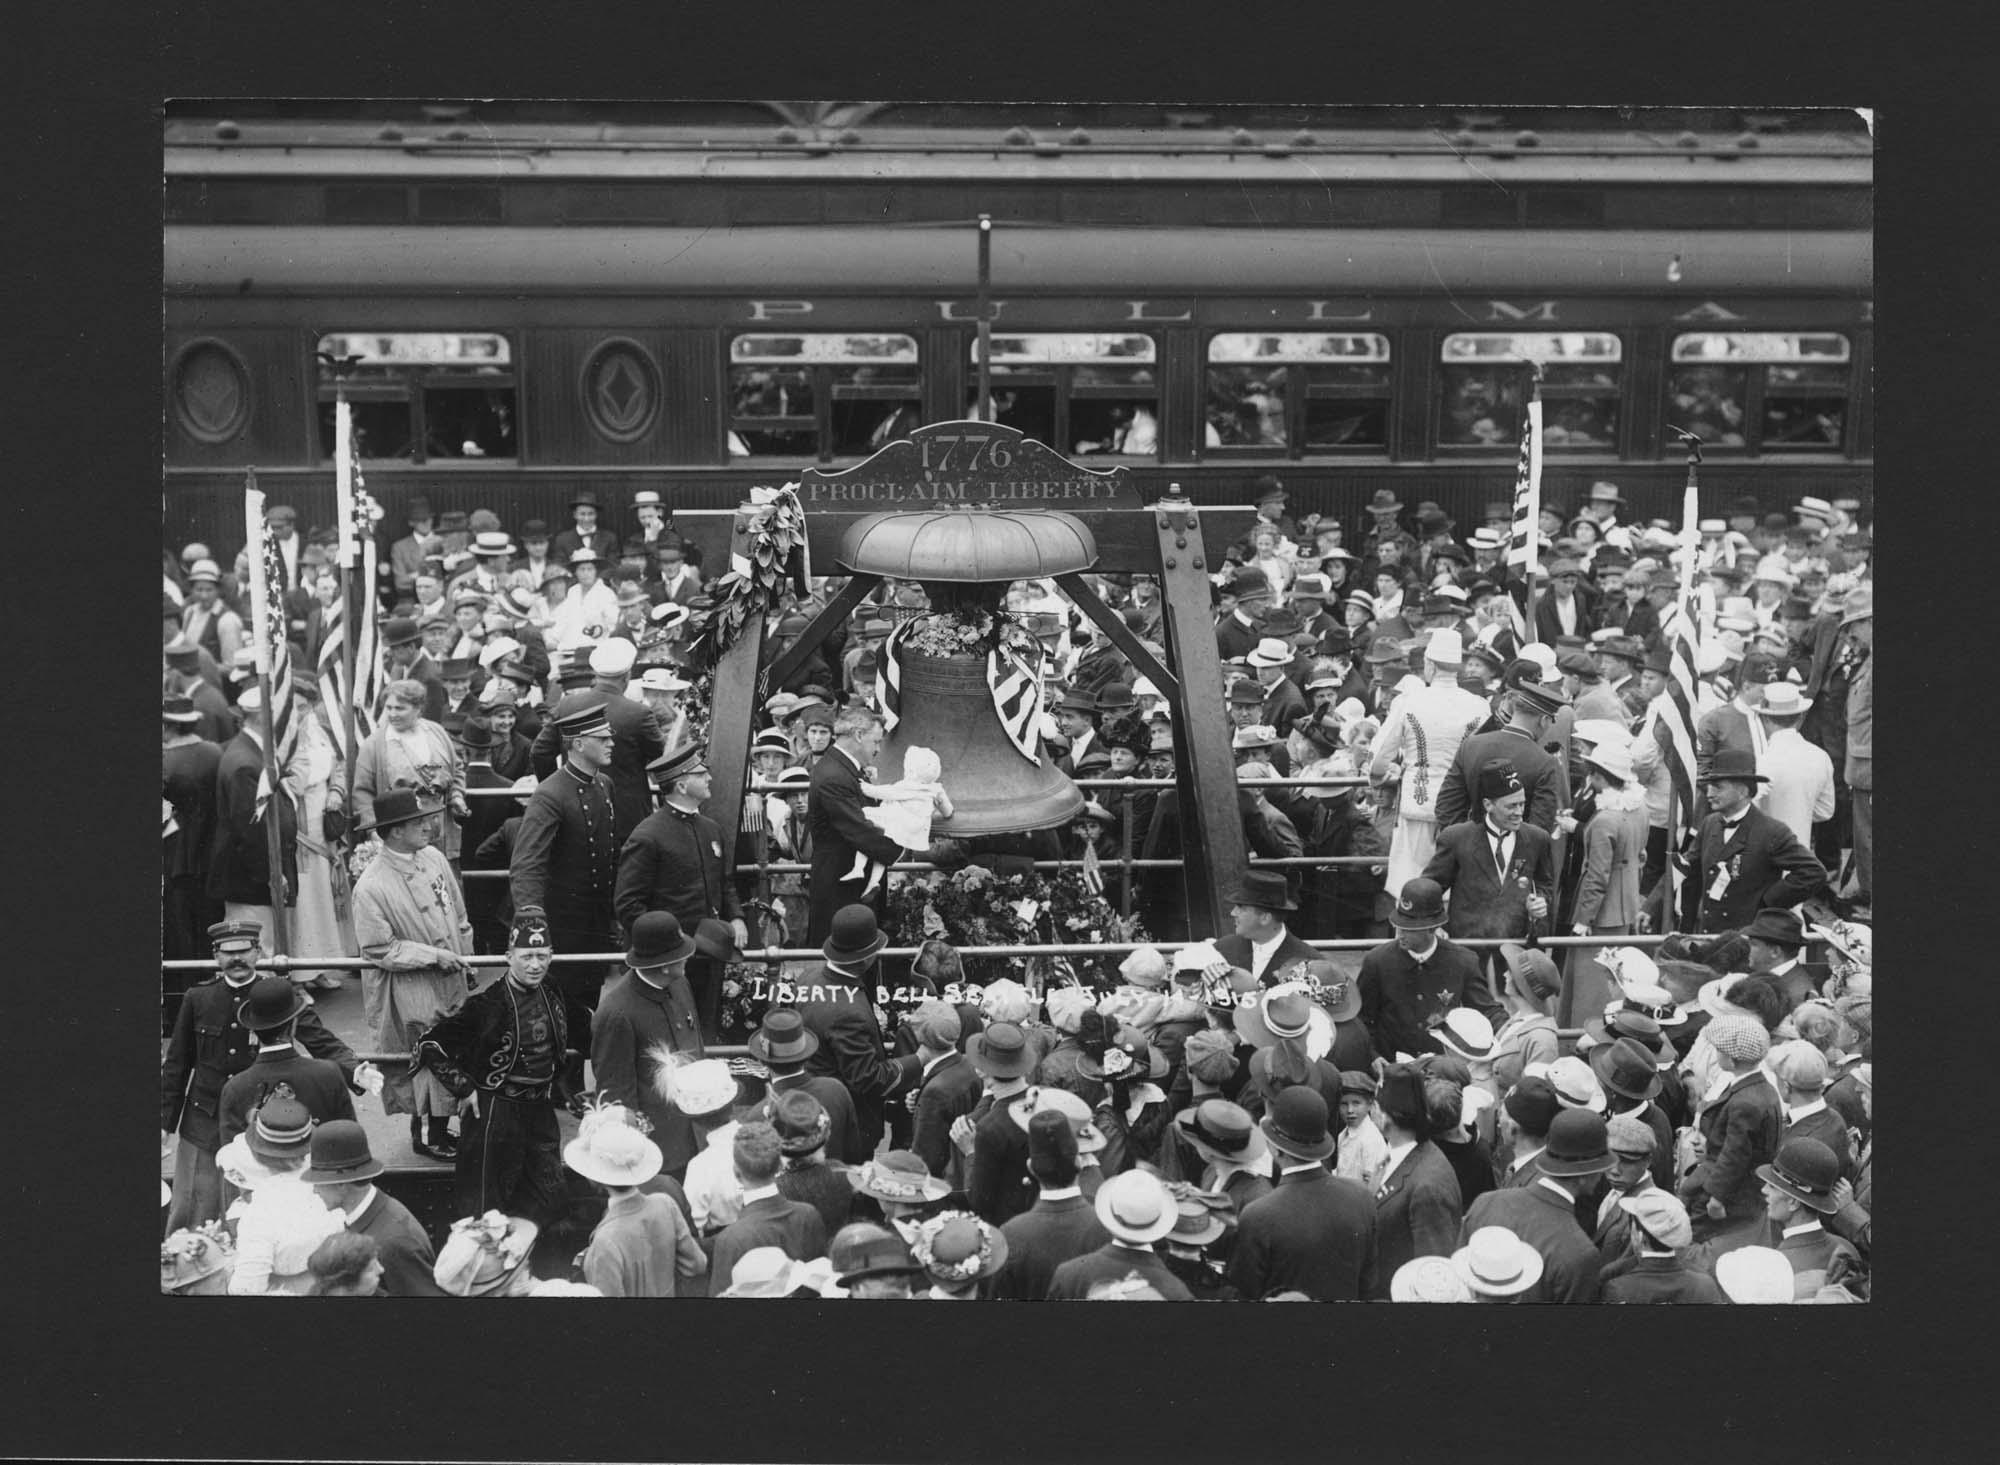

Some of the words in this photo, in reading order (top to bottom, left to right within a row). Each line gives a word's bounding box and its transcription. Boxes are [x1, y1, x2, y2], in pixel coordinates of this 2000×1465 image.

[748, 300, 1874, 322] PULLMA
[921, 435, 1012, 471] 1776
[809, 481, 967, 501] PROCLAIM
[987, 481, 1121, 500] LIBERTY
